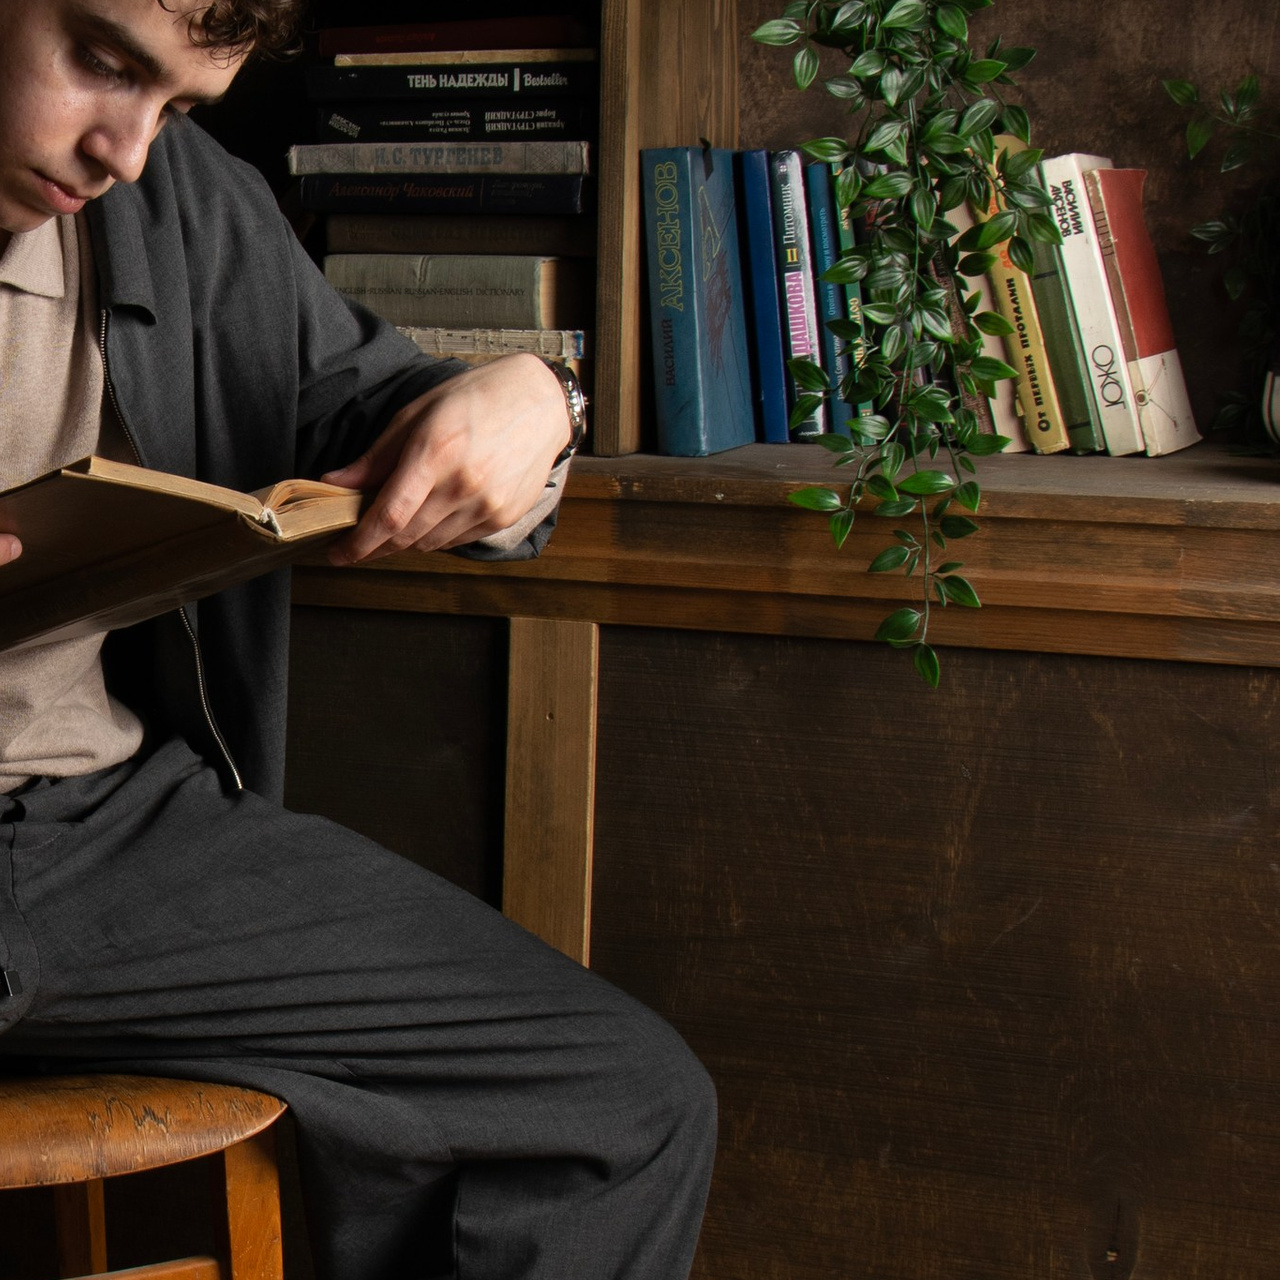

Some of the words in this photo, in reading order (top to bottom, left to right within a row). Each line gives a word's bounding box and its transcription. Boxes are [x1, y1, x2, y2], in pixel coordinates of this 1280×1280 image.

[407, 74, 436, 87] ТЕНЬ
[439, 72, 508, 87] НАДЕЖДЫ
[523, 72, 568, 86] Bestseller
[484, 109, 534, 122] СТРУГАЦКИЙ
[535, 108, 555, 118] Борис
[485, 120, 534, 133] СТРУГАЦКИЙ
[410, 147, 502, 166] ТУРГЕНЕВ
[329, 182, 400, 200] Александр
[402, 182, 475, 198] Чаковский
[1045, 182, 1076, 237] АКСЕНОВ
[653, 161, 684, 311] АКСЕНОВ
[818, 207, 829, 248] посмотреть
[660, 319, 675, 385] ВАСИЛИЙ
